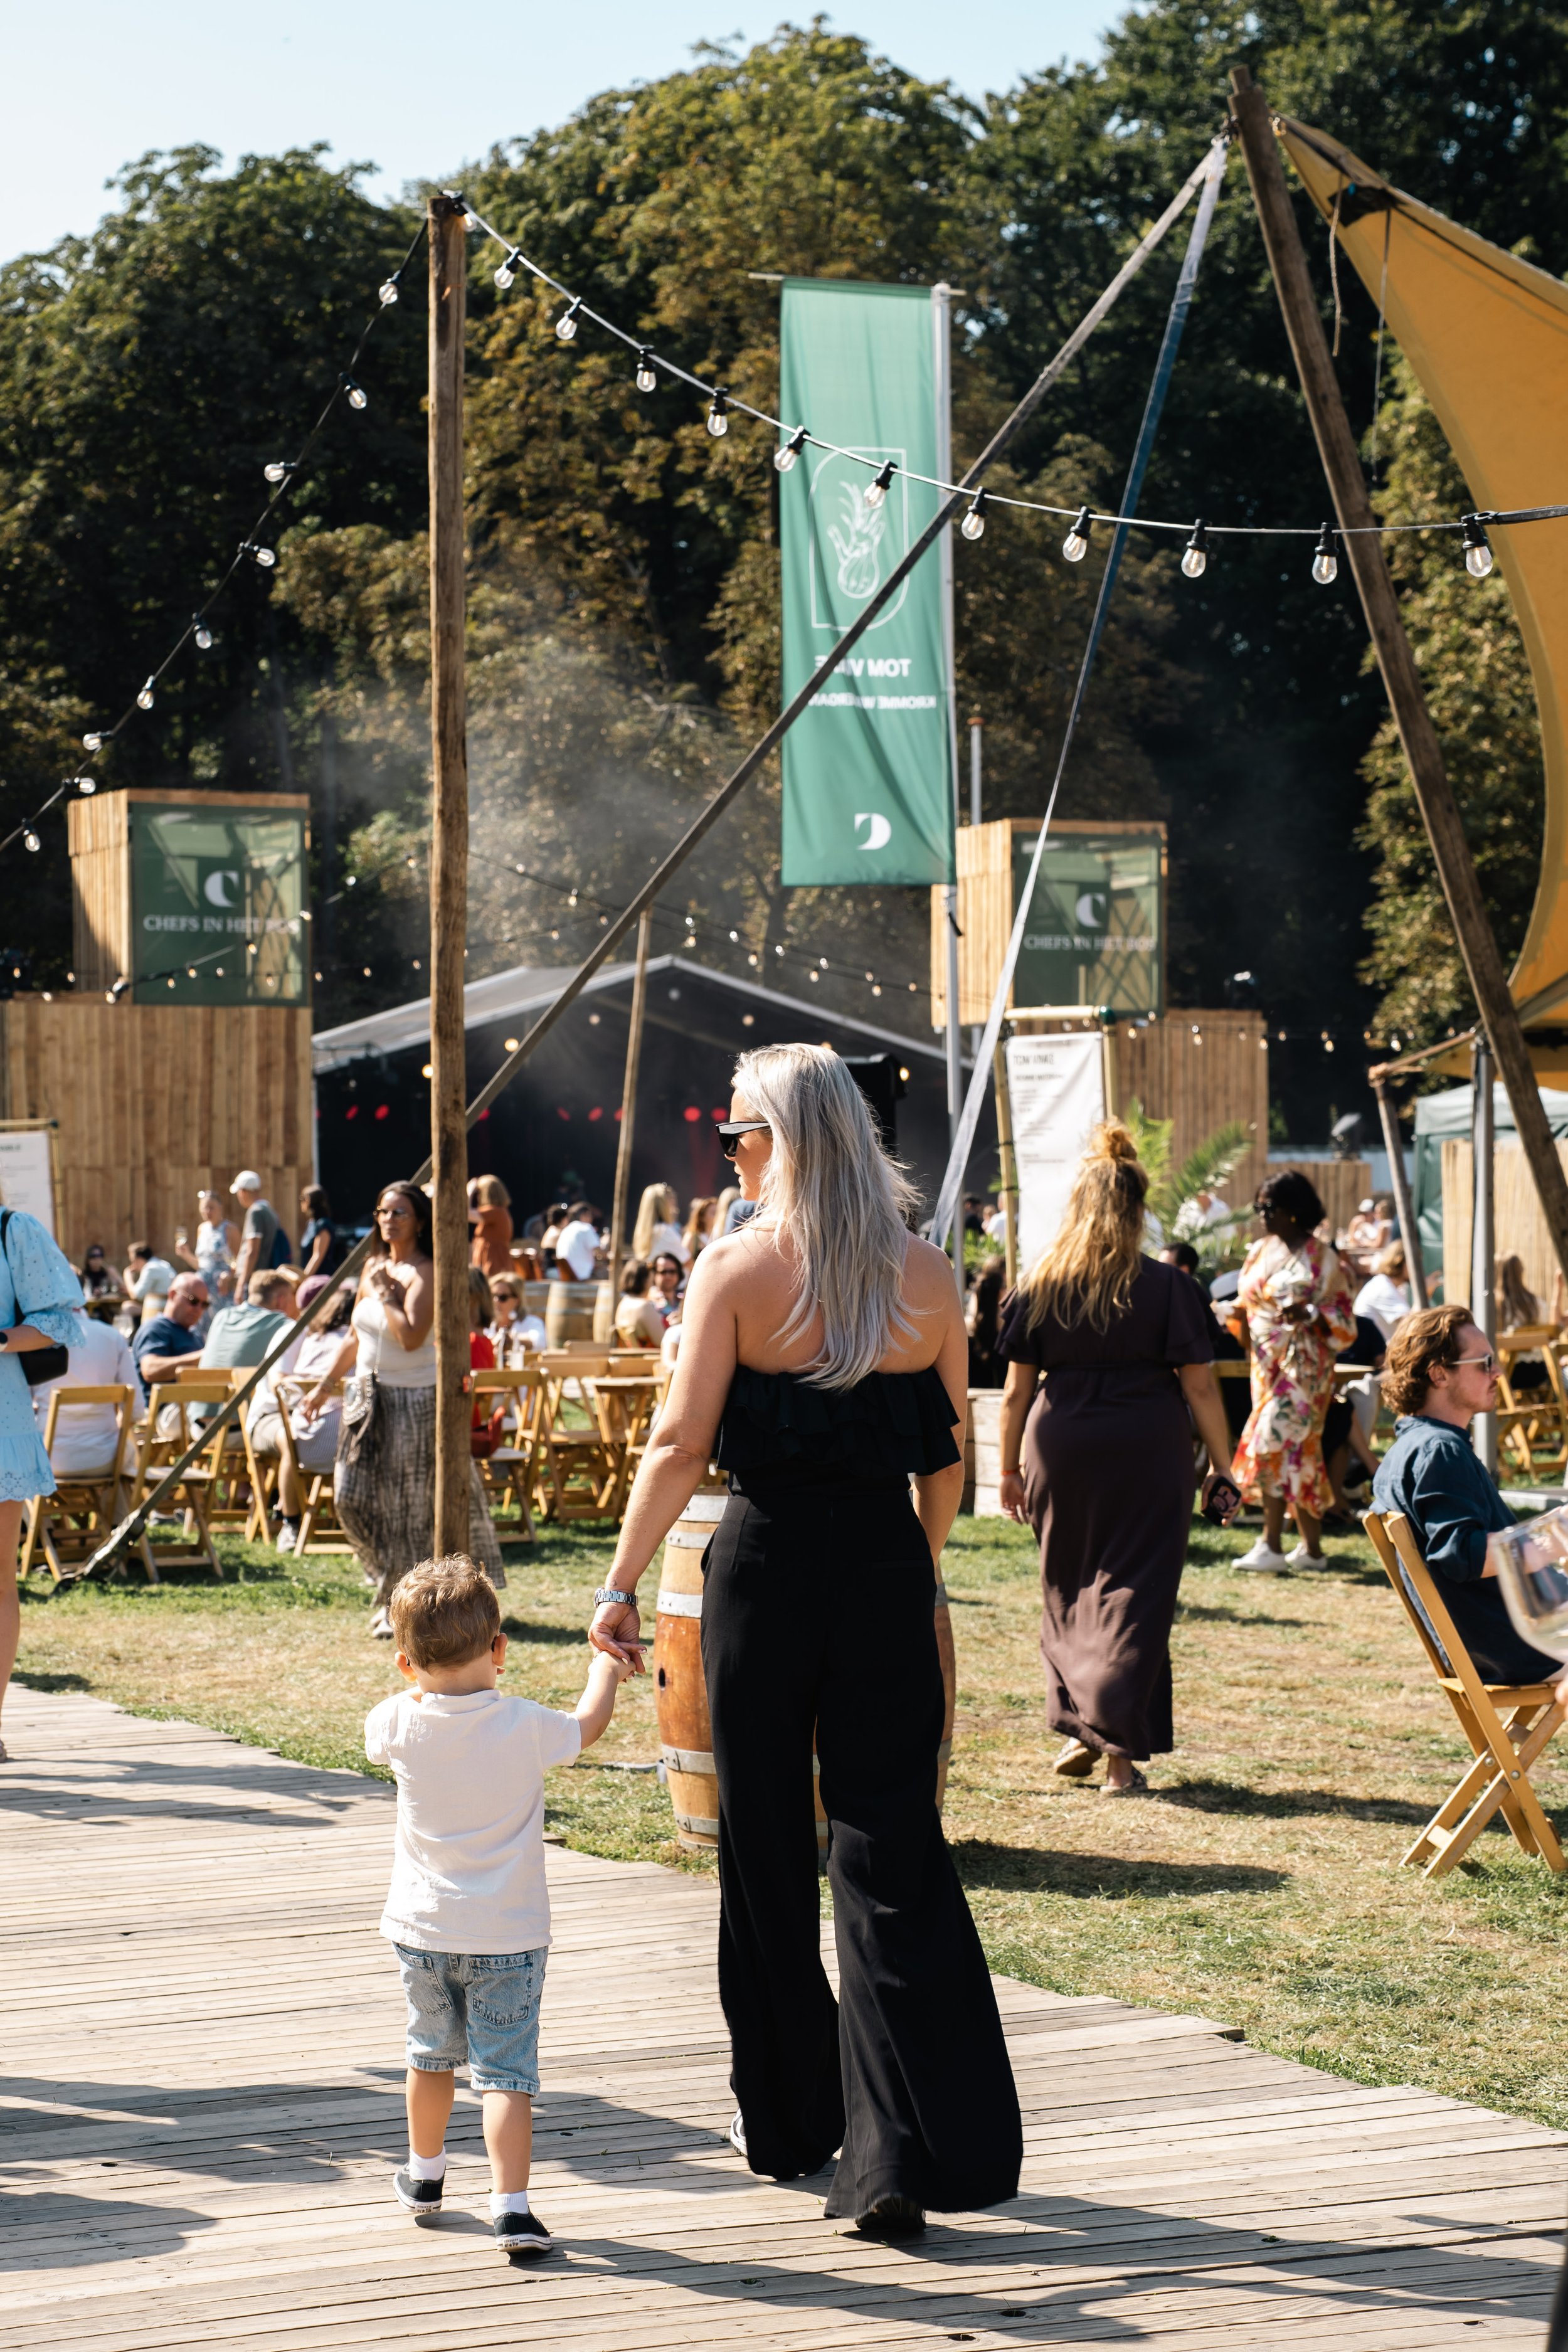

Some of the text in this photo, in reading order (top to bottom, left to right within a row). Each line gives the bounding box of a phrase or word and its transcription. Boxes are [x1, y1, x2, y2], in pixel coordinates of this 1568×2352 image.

[144, 914, 200, 932] CHEFS
[203, 916, 223, 933] IN
[1024, 934, 1071, 950] CHEFS
[1074, 935, 1091, 950] IN
